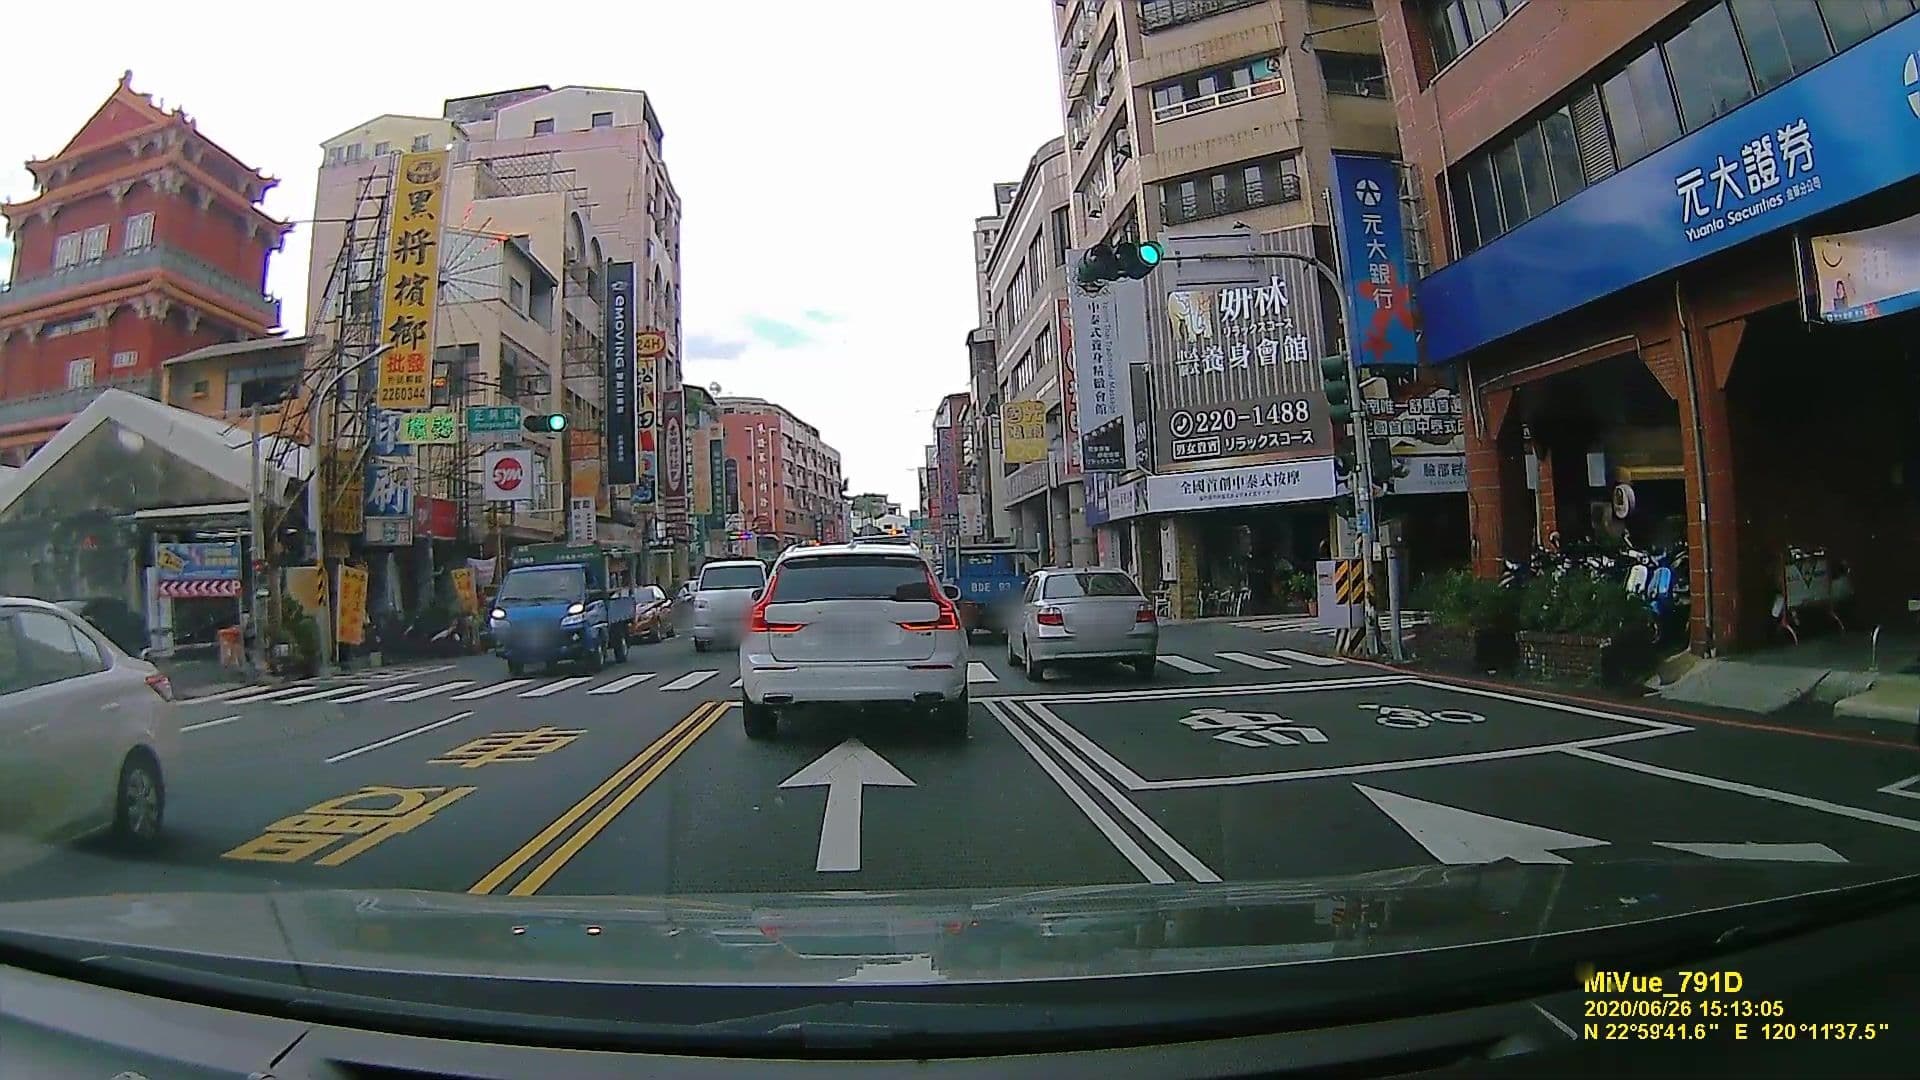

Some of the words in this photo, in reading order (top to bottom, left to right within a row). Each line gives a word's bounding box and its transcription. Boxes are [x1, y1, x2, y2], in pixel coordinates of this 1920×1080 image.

[1675, 118, 1814, 224] 元大證券
[1685, 217, 1725, 242] Yuanta
[1727, 194, 1784, 226] Securities
[390, 189, 437, 350] 黑將檳榔
[1362, 214, 1393, 310] 元大銀行
[637, 337, 660, 351] 24H
[387, 353, 425, 373] 批發
[382, 387, 426, 401] 2260344
[1195, 400, 1309, 433] 220-1488
[1224, 430, 1314, 452] リラックスコース
[494, 467, 523, 485] SYM
